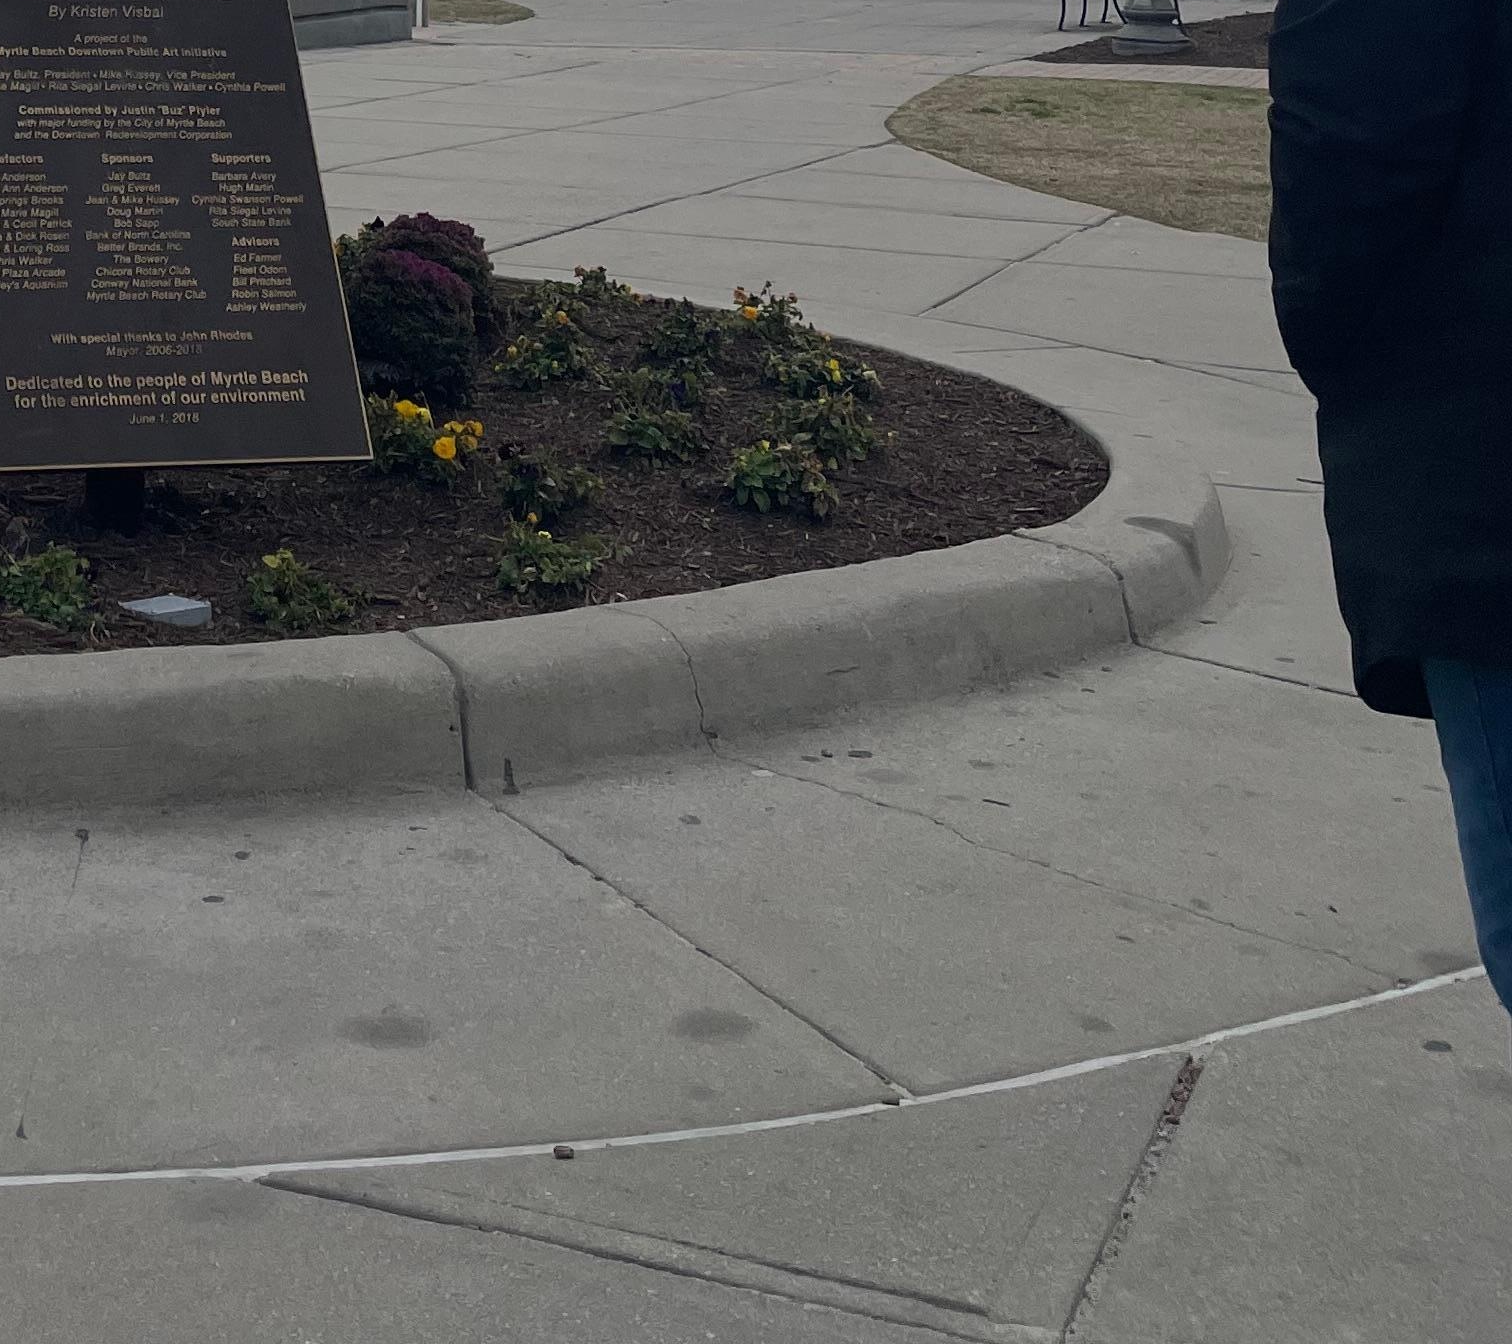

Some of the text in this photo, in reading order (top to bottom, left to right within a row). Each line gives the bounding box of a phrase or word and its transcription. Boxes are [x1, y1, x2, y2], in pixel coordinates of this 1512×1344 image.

[49, 5, 164, 20] By Kristen Visbal
[74, 34, 82, 43] A
[84, 34, 118, 45] project
[133, 34, 147, 44] the
[32, 47, 65, 56] Beach
[68, 47, 124, 56] Downtown
[127, 47, 158, 57] Public
[163, 47, 179, 57] Art
[181, 48, 227, 57] Initiative
[44, 70, 90, 79] President
[167, 71, 188, 80] Vice
[191, 71, 235, 80] President
[145, 83, 170, 91] Chris
[173, 83, 207, 91] Walker
[214, 83, 251, 93] Cynthia
[254, 83, 285, 91] Powell
[18, 105, 101, 115] Commissioned
[104, 106, 117, 117] by
[121, 106, 155, 115] Justin
[17, 119, 36, 127] with
[39, 119, 65, 129] major
[67, 119, 101, 129] funding
[104, 119, 115, 129] by
[118, 119, 132, 127] the
[134, 119, 152, 129] City
[167, 119, 194, 129] Myrtle
[197, 119, 225, 127] Beach
[14, 131, 232, 140] and the Downtown Redevelopment Corporation
[102, 154, 153, 165] Sponsors
[211, 154, 272, 165] Supporters
[2, 173, 46, 182] Anderson
[108, 172, 125, 181] Jay
[212, 172, 248, 181] Barbara
[24, 185, 68, 193] Anderson
[219, 184, 274, 194] Hugh Martin
[31, 196, 64, 205] Brooks
[274, 194, 304, 203] Powell
[114, 219, 132, 228] Bob
[242, 218, 266, 227] State
[269, 218, 292, 226] Bank
[86, 231, 109, 240] Bank
[124, 231, 149, 239] North
[152, 230, 191, 239] Carolina
[232, 237, 280, 246] Advisors
[19, 256, 52, 265] Walker
[114, 255, 169, 264] The Bowery
[2, 268, 29, 278] Plaza
[32, 268, 66, 277] Arcade
[136, 267, 167, 277] Rotary
[169, 266, 191, 275] Club
[22, 281, 68, 290] Aquarium
[132, 278, 171, 287] National
[174, 278, 198, 287] Bank
[87, 290, 207, 302] Myrtle Beach Rotary Club
[51, 330, 253, 345] With special thanks to John Rhodes
[5, 370, 308, 391] Dedicated to the people of Myrtle Beach
[14, 388, 306, 409] for the enrichment of our environment
[129, 414, 155, 424] June
[172, 413, 200, 423] 2018
